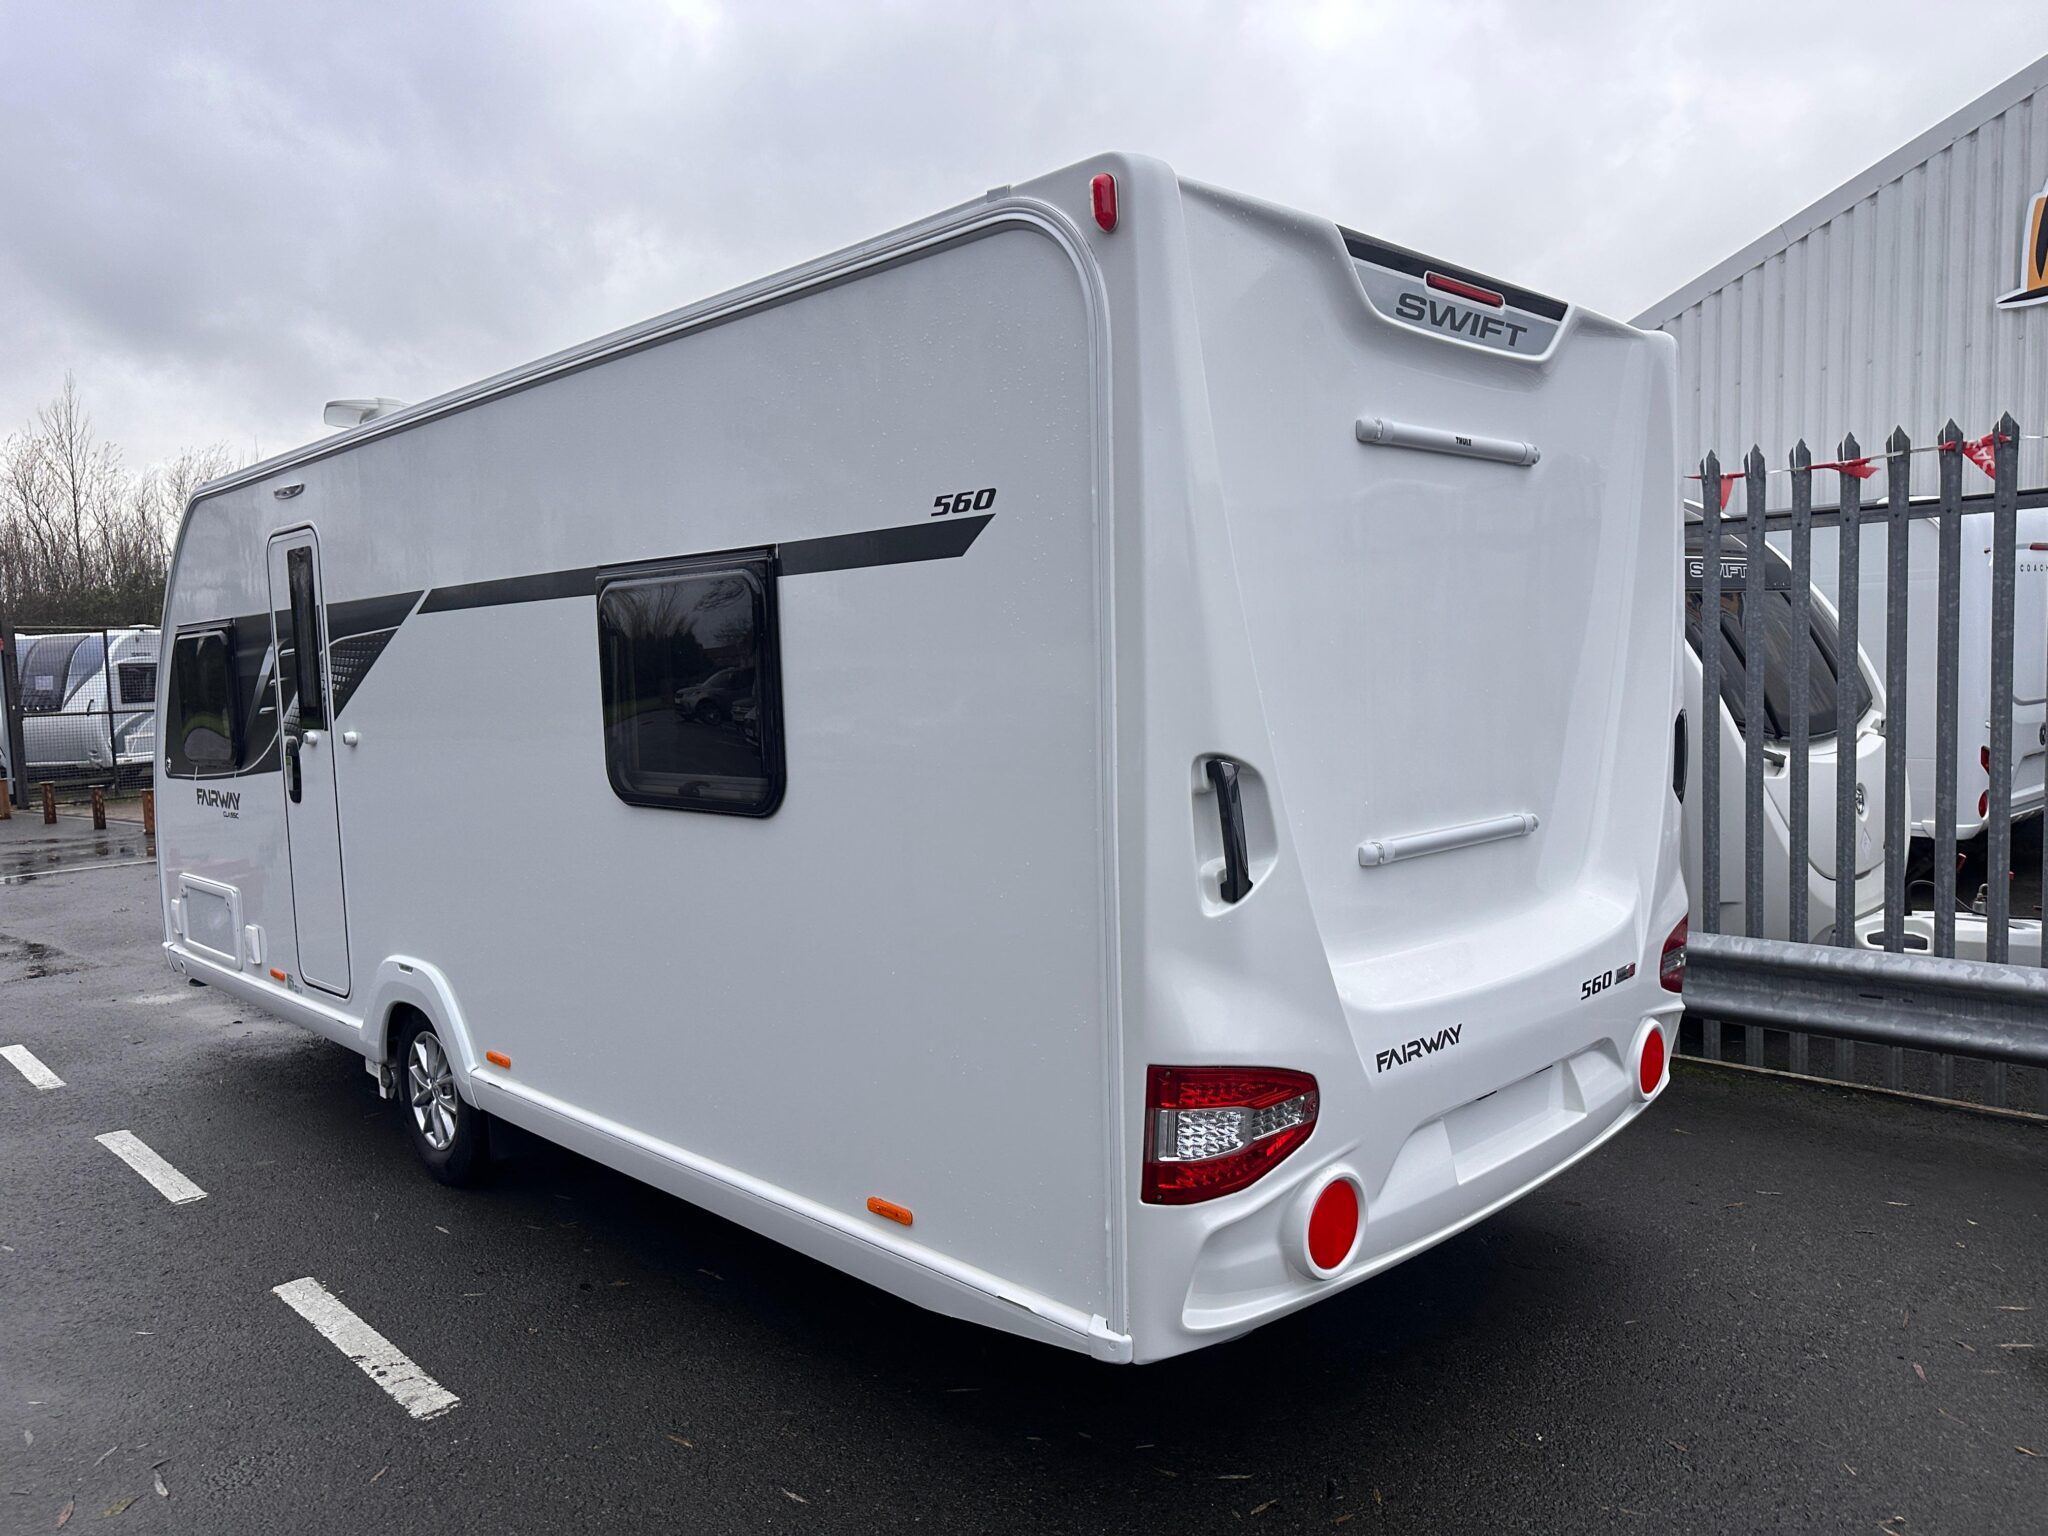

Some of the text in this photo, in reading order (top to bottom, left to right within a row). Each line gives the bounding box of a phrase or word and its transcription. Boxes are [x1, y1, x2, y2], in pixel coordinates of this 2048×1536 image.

[1396, 292, 1528, 347] SWIFT
[1455, 436, 1472, 447] THULE
[930, 488, 997, 517] 560
[1690, 562, 1748, 578] SIFT
[196, 788, 241, 811] FAIRWAY
[1580, 970, 1613, 1000] 560
[1376, 1023, 1463, 1073] FAIRWAY
